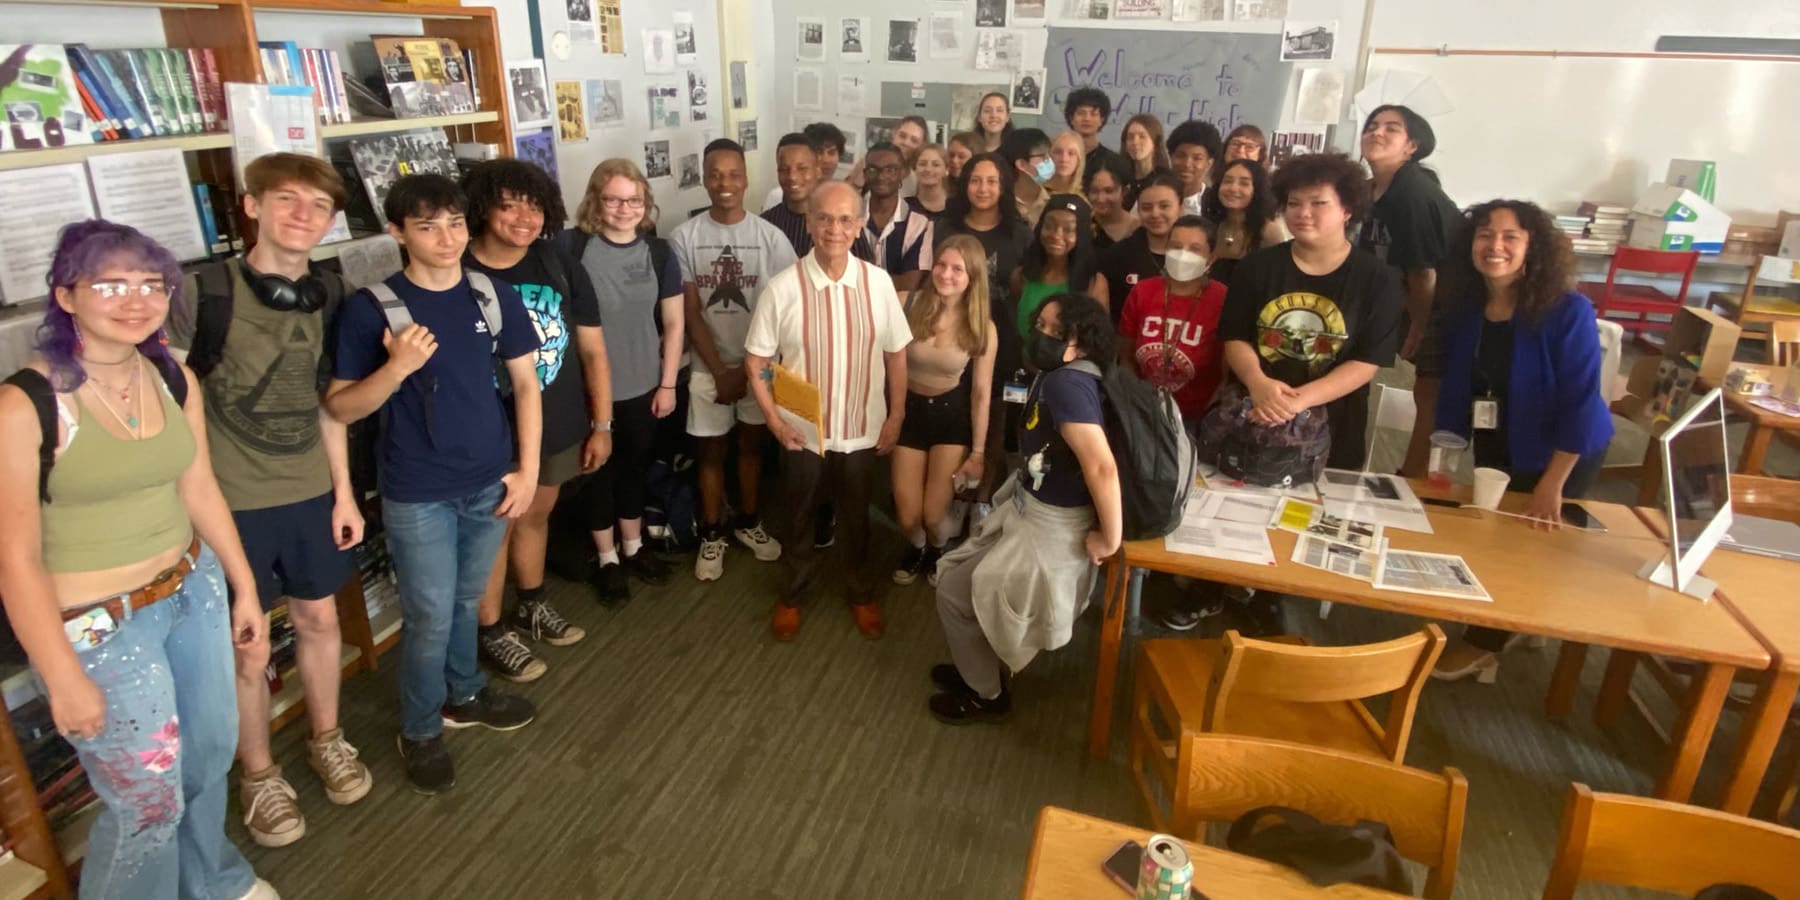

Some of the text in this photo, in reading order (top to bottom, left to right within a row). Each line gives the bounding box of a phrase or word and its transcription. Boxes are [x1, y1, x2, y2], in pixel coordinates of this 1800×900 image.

[1064, 47, 1241, 97] Welcome to
[0, 116, 65, 149] LO
[512, 283, 563, 319] EN
[1142, 315, 1203, 347] CTU
